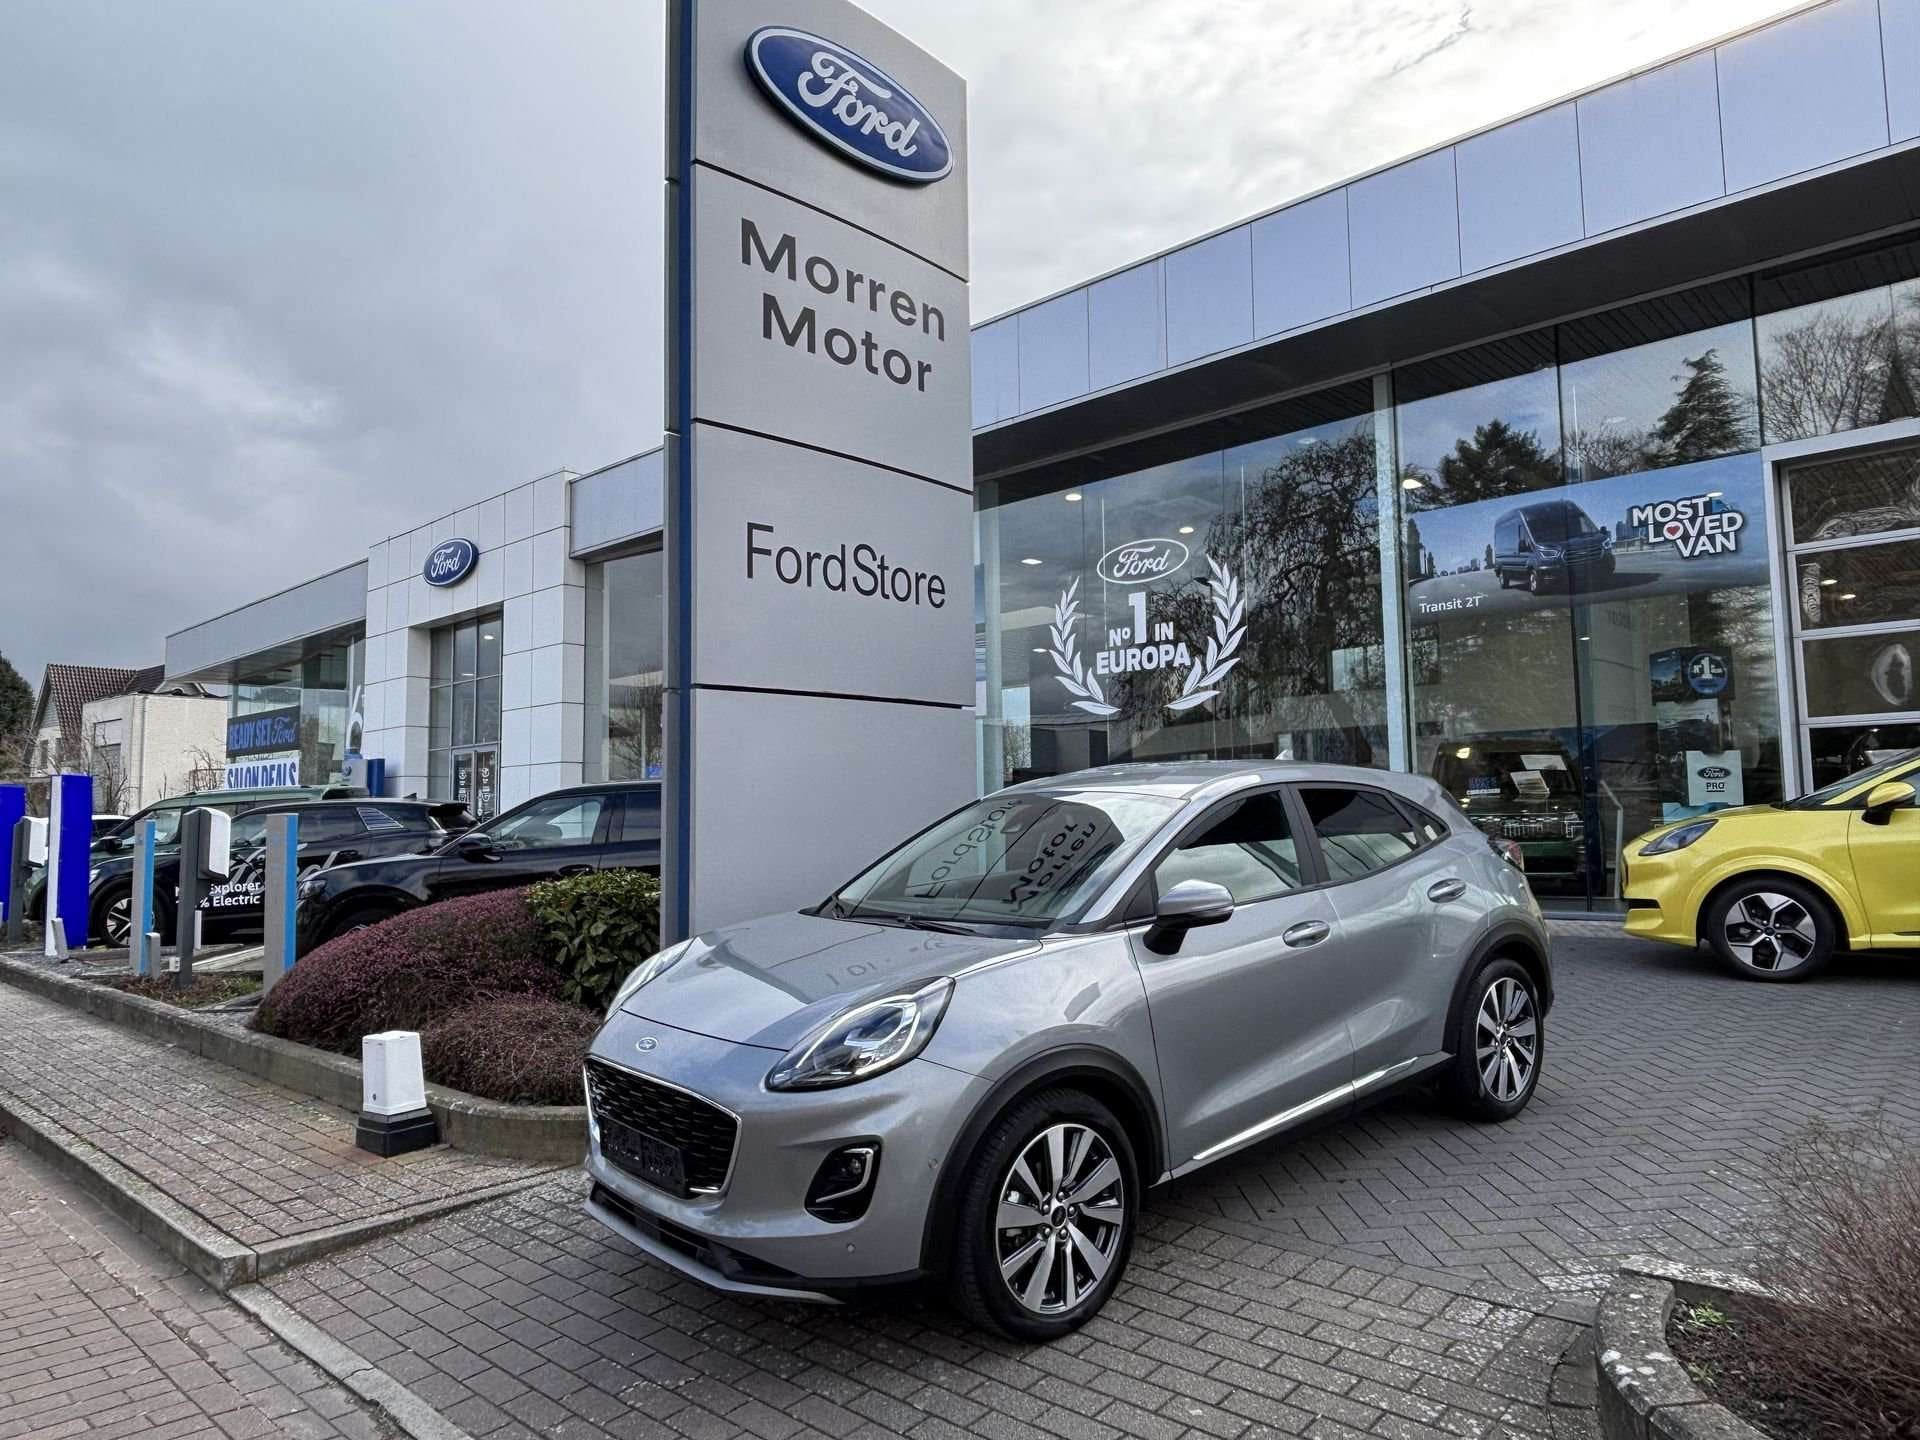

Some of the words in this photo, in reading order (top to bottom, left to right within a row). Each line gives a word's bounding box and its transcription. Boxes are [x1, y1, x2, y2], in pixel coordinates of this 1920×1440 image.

[797, 51, 920, 157] Ford
[741, 217, 945, 342] Morren
[762, 292, 932, 392] Motor
[1632, 496, 1710, 527] MOST
[1648, 512, 1743, 543] LOVED
[1113, 545, 1170, 577] Ford
[1675, 532, 1736, 558] VAN
[430, 546, 461, 578] Ford
[746, 521, 946, 609] FordStore
[1128, 591, 1147, 644] 1
[1154, 622, 1174, 642] IN
[1418, 598, 1463, 614] Transit
[1465, 595, 1483, 608] 2T
[1096, 642, 1191, 675] EUROPA
[256, 718, 272, 747] SET
[272, 715, 298, 745] Ford
[1703, 767, 1725, 778] Ford
[1706, 782, 1725, 790] PRO
[213, 893, 261, 907] Electric
